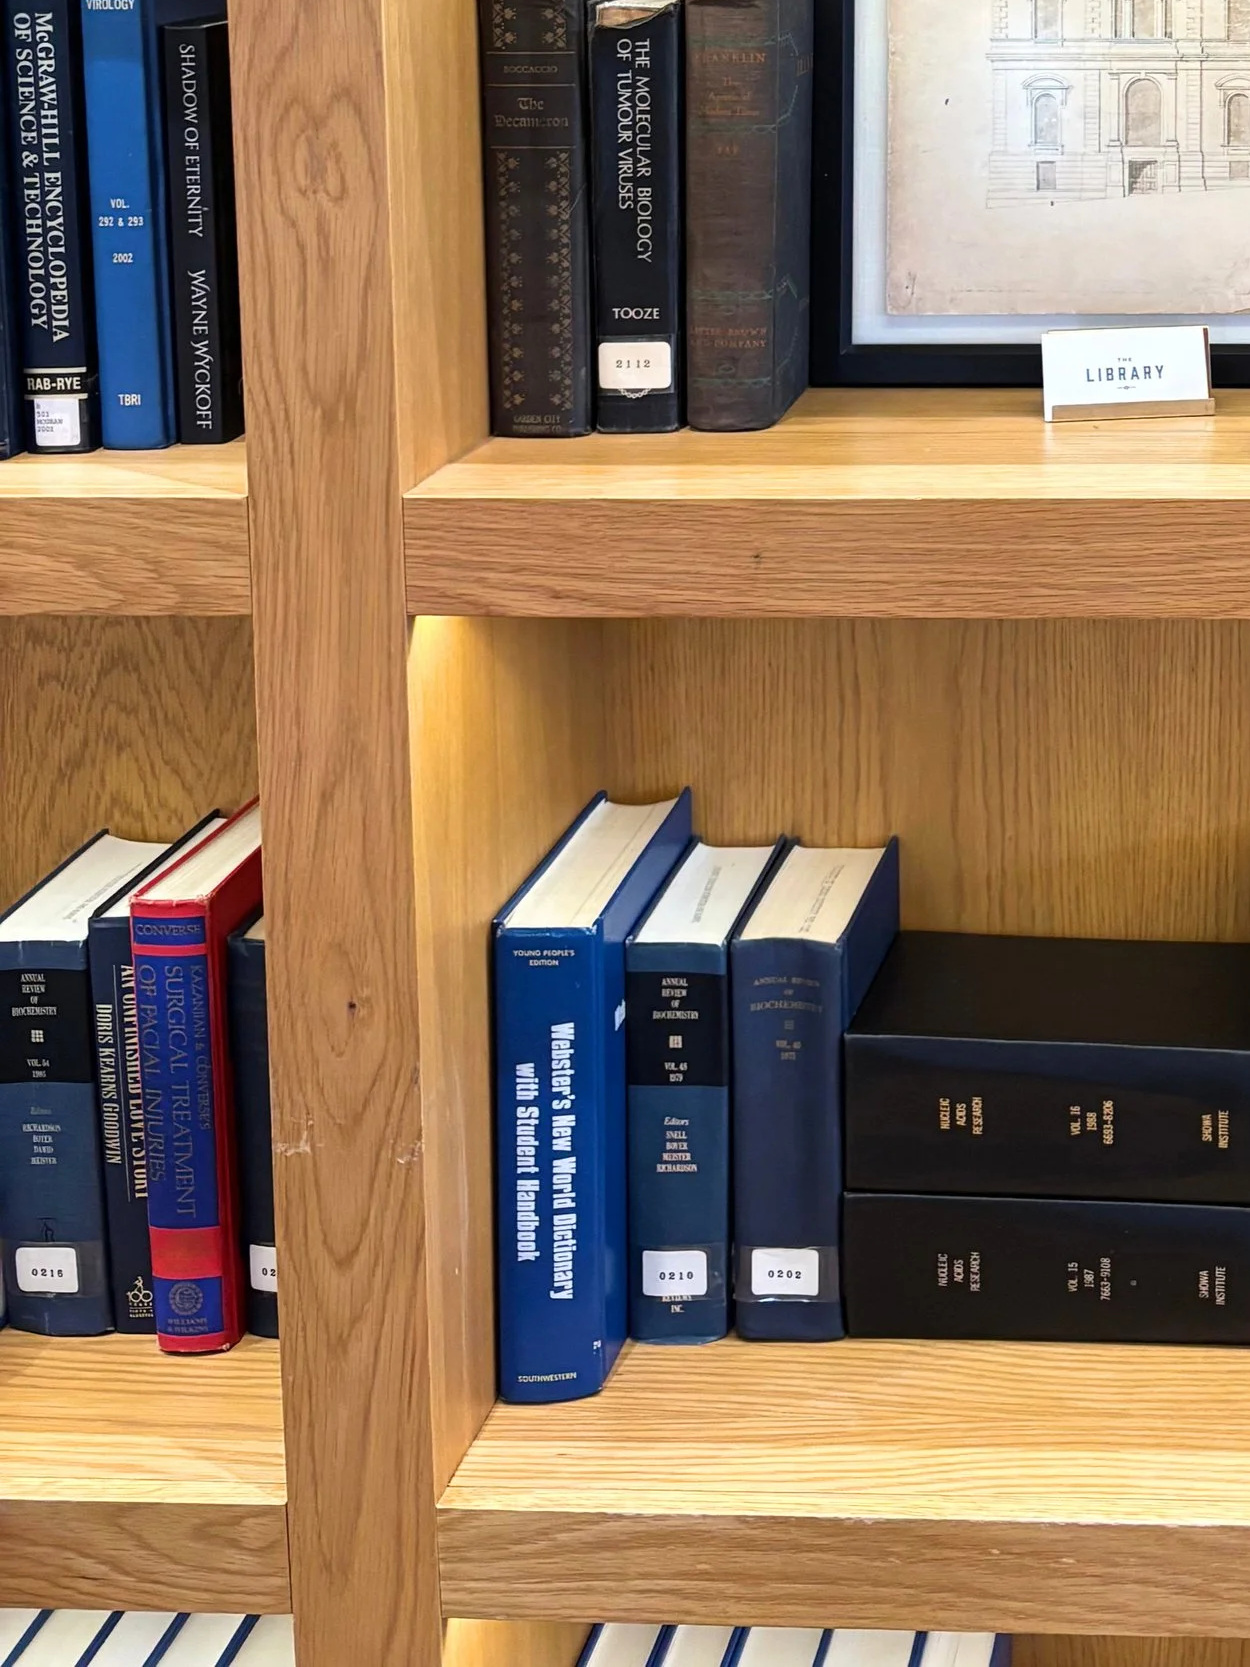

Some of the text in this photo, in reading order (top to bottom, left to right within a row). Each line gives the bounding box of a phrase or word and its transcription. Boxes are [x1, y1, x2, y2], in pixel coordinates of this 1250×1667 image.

[616, 38, 634, 210] OF TUMOUR VIRUSES
[179, 44, 207, 237] SHADOW OF ETERNITY
[635, 38, 653, 263] THE MOLECULAR BIOLOGY
[13, 12, 48, 329] OF SCIENCE & TECHNOLOGY
[34, 12, 70, 343] McGRAW-HILL ENCYCLOPEDIA
[112, 253, 134, 263] 2002
[612, 308, 660, 319] TOOZE
[187, 269, 213, 429] WAYNE WYCKOFF
[615, 359, 651, 369] 2112
[1086, 364, 1164, 383] LIBRARY
[27, 377, 81, 391] RAB-RYE
[118, 394, 141, 406] TBRI
[95, 1003, 122, 1165] DORIS KEARNS GOODWIN
[515, 1062, 541, 1261] with Student Handbook
[549, 1022, 578, 1300] Webster's New World Dictionary
[31, 1267, 64, 1279] 0216
[658, 1270, 694, 1281] 0210
[768, 1269, 802, 1280] 0202
[938, 1253, 948, 1286] NUCLEIC
[954, 1259, 964, 1283] ACIDS
[970, 1251, 981, 1292] RESEARCH
[1084, 1268, 1095, 1288] 1987
